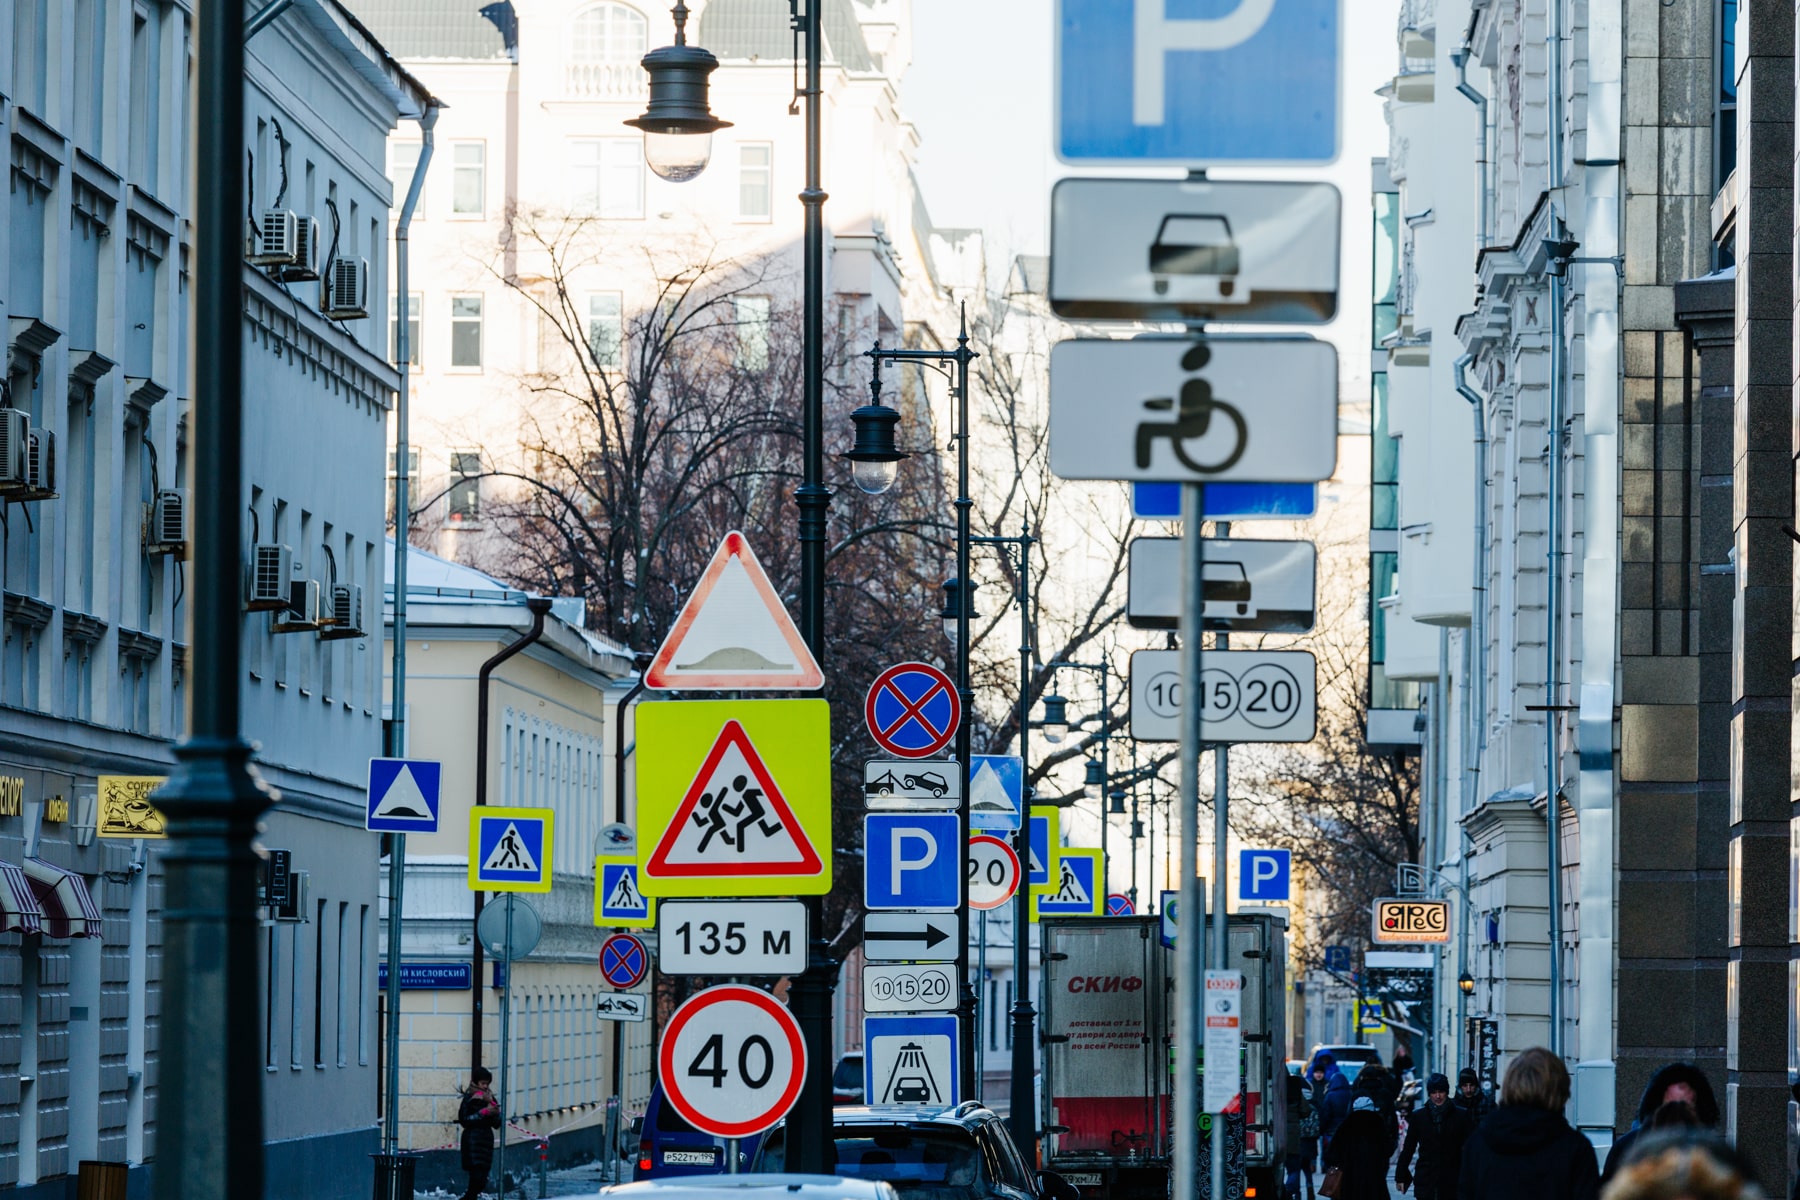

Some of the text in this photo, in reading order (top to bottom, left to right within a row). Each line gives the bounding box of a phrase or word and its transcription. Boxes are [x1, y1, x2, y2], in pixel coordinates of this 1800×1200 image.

[1133, 0, 1277, 125] P
[1200, 682, 1231, 709] 15
[1246, 680, 1292, 712] 20
[891, 828, 938, 895] P
[969, 859, 1005, 886] 20
[1252, 856, 1279, 894] P
[676, 922, 747, 955] 135
[411, 968, 466, 977] КИСЛОВСКИЙ
[874, 978, 946, 996] 10 15 20
[1068, 976, 1143, 993] СКИФ
[688, 1034, 774, 1089] 40
